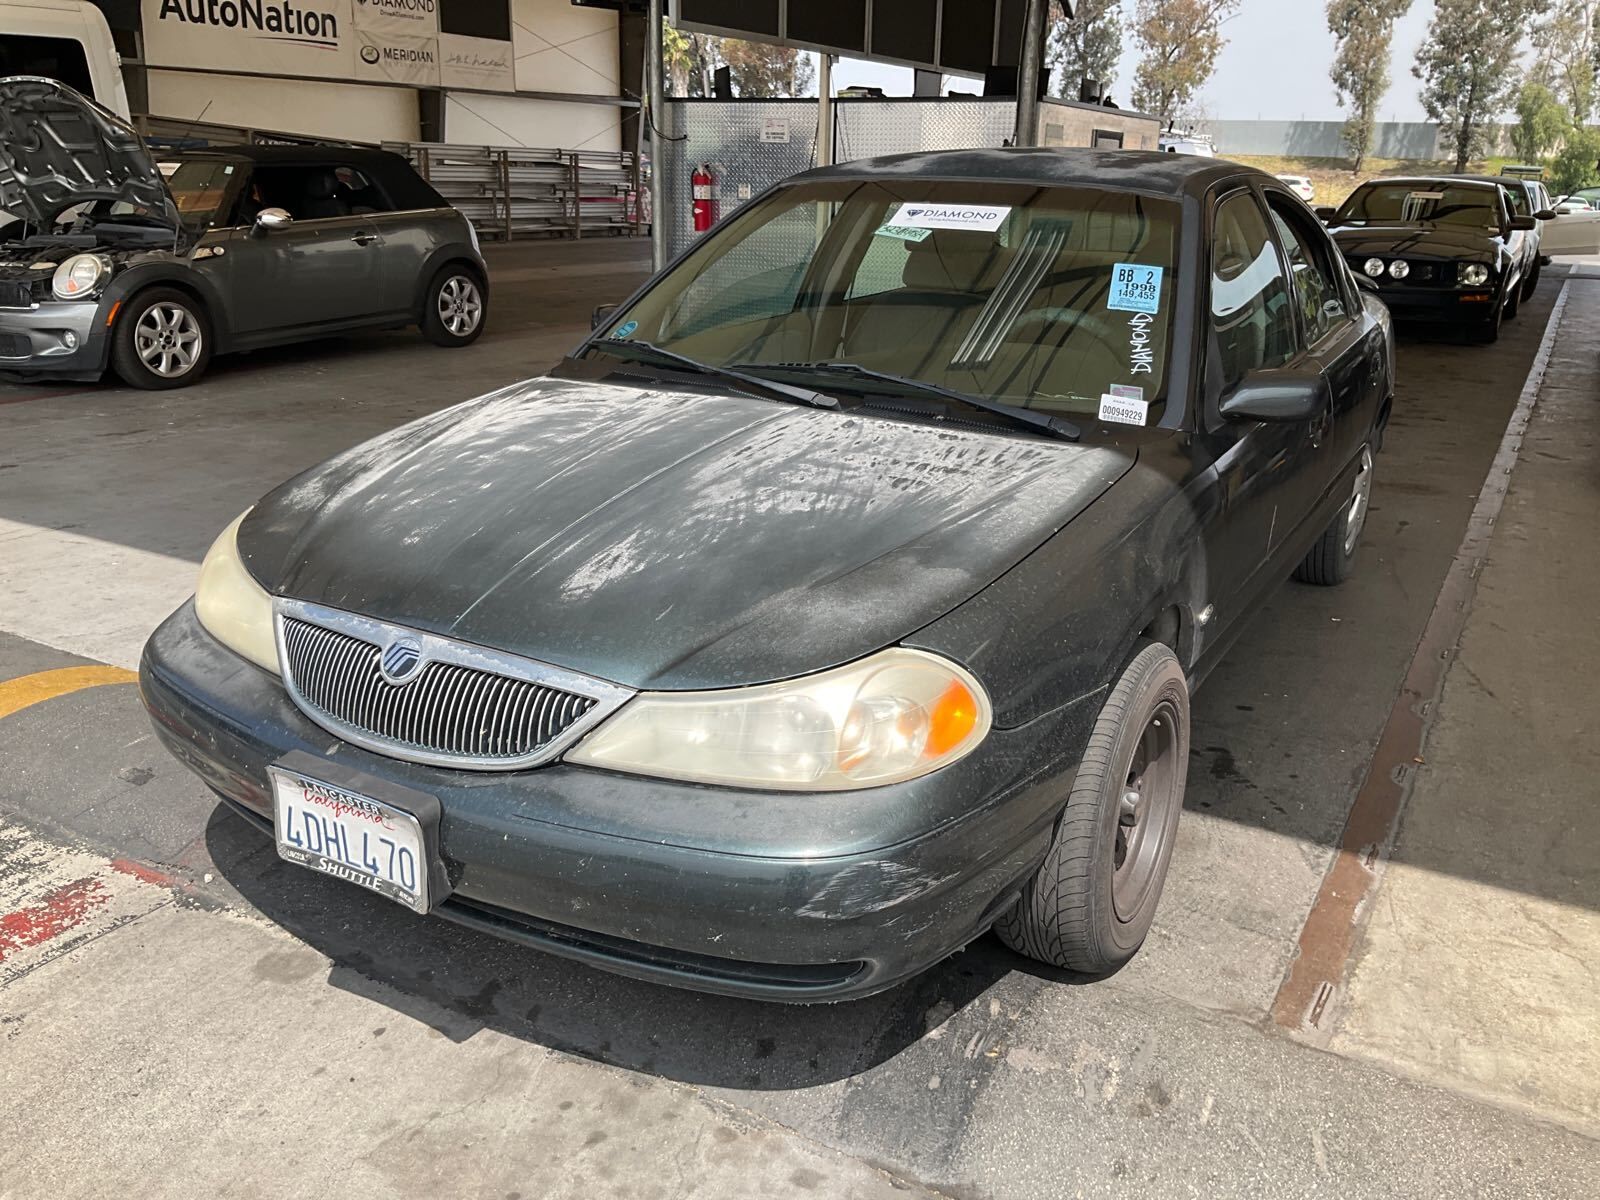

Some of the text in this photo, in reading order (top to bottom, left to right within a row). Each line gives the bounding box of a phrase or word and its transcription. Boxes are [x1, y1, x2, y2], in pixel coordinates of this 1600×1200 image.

[159, 0, 338, 38] AutoNation
[383, 47, 434, 63] MERIDIAN
[923, 209, 998, 220] DIAMOND
[1118, 268, 1154, 285] BB 2
[1118, 289, 1155, 300] 149,455
[1123, 282, 1156, 293] 1998
[1127, 312, 1153, 374] DIAMOND
[1102, 405, 1143, 421] 000949229
[304, 781, 381, 815] LANCASTER
[318, 857, 383, 891] SHUTTLE
